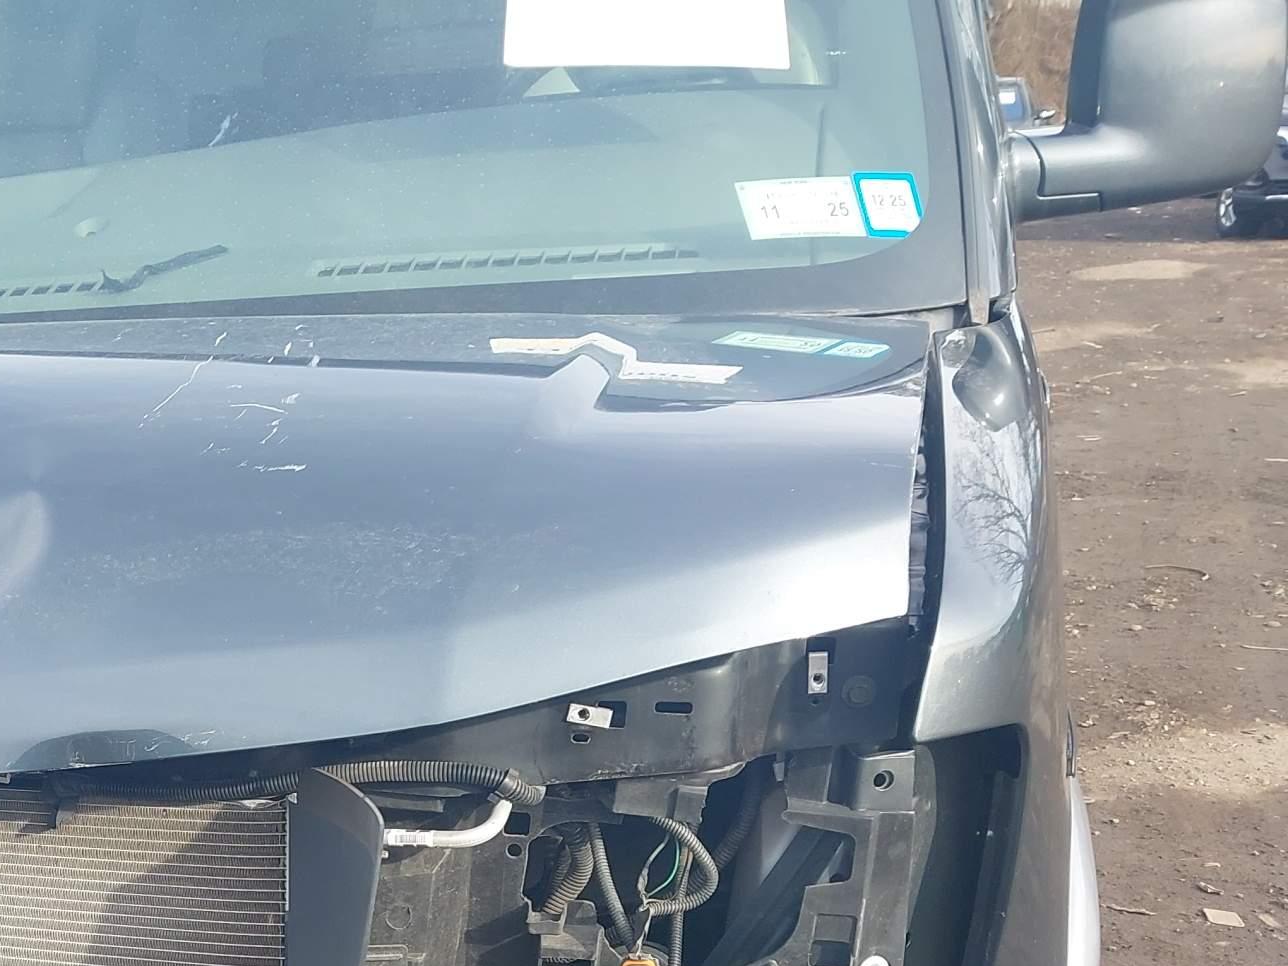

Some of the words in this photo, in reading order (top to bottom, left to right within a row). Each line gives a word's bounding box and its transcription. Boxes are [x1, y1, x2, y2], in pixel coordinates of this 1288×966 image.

[871, 194, 885, 207] 12
[889, 194, 907, 207] 25
[760, 204, 780, 219] 11
[826, 201, 850, 217] 25
